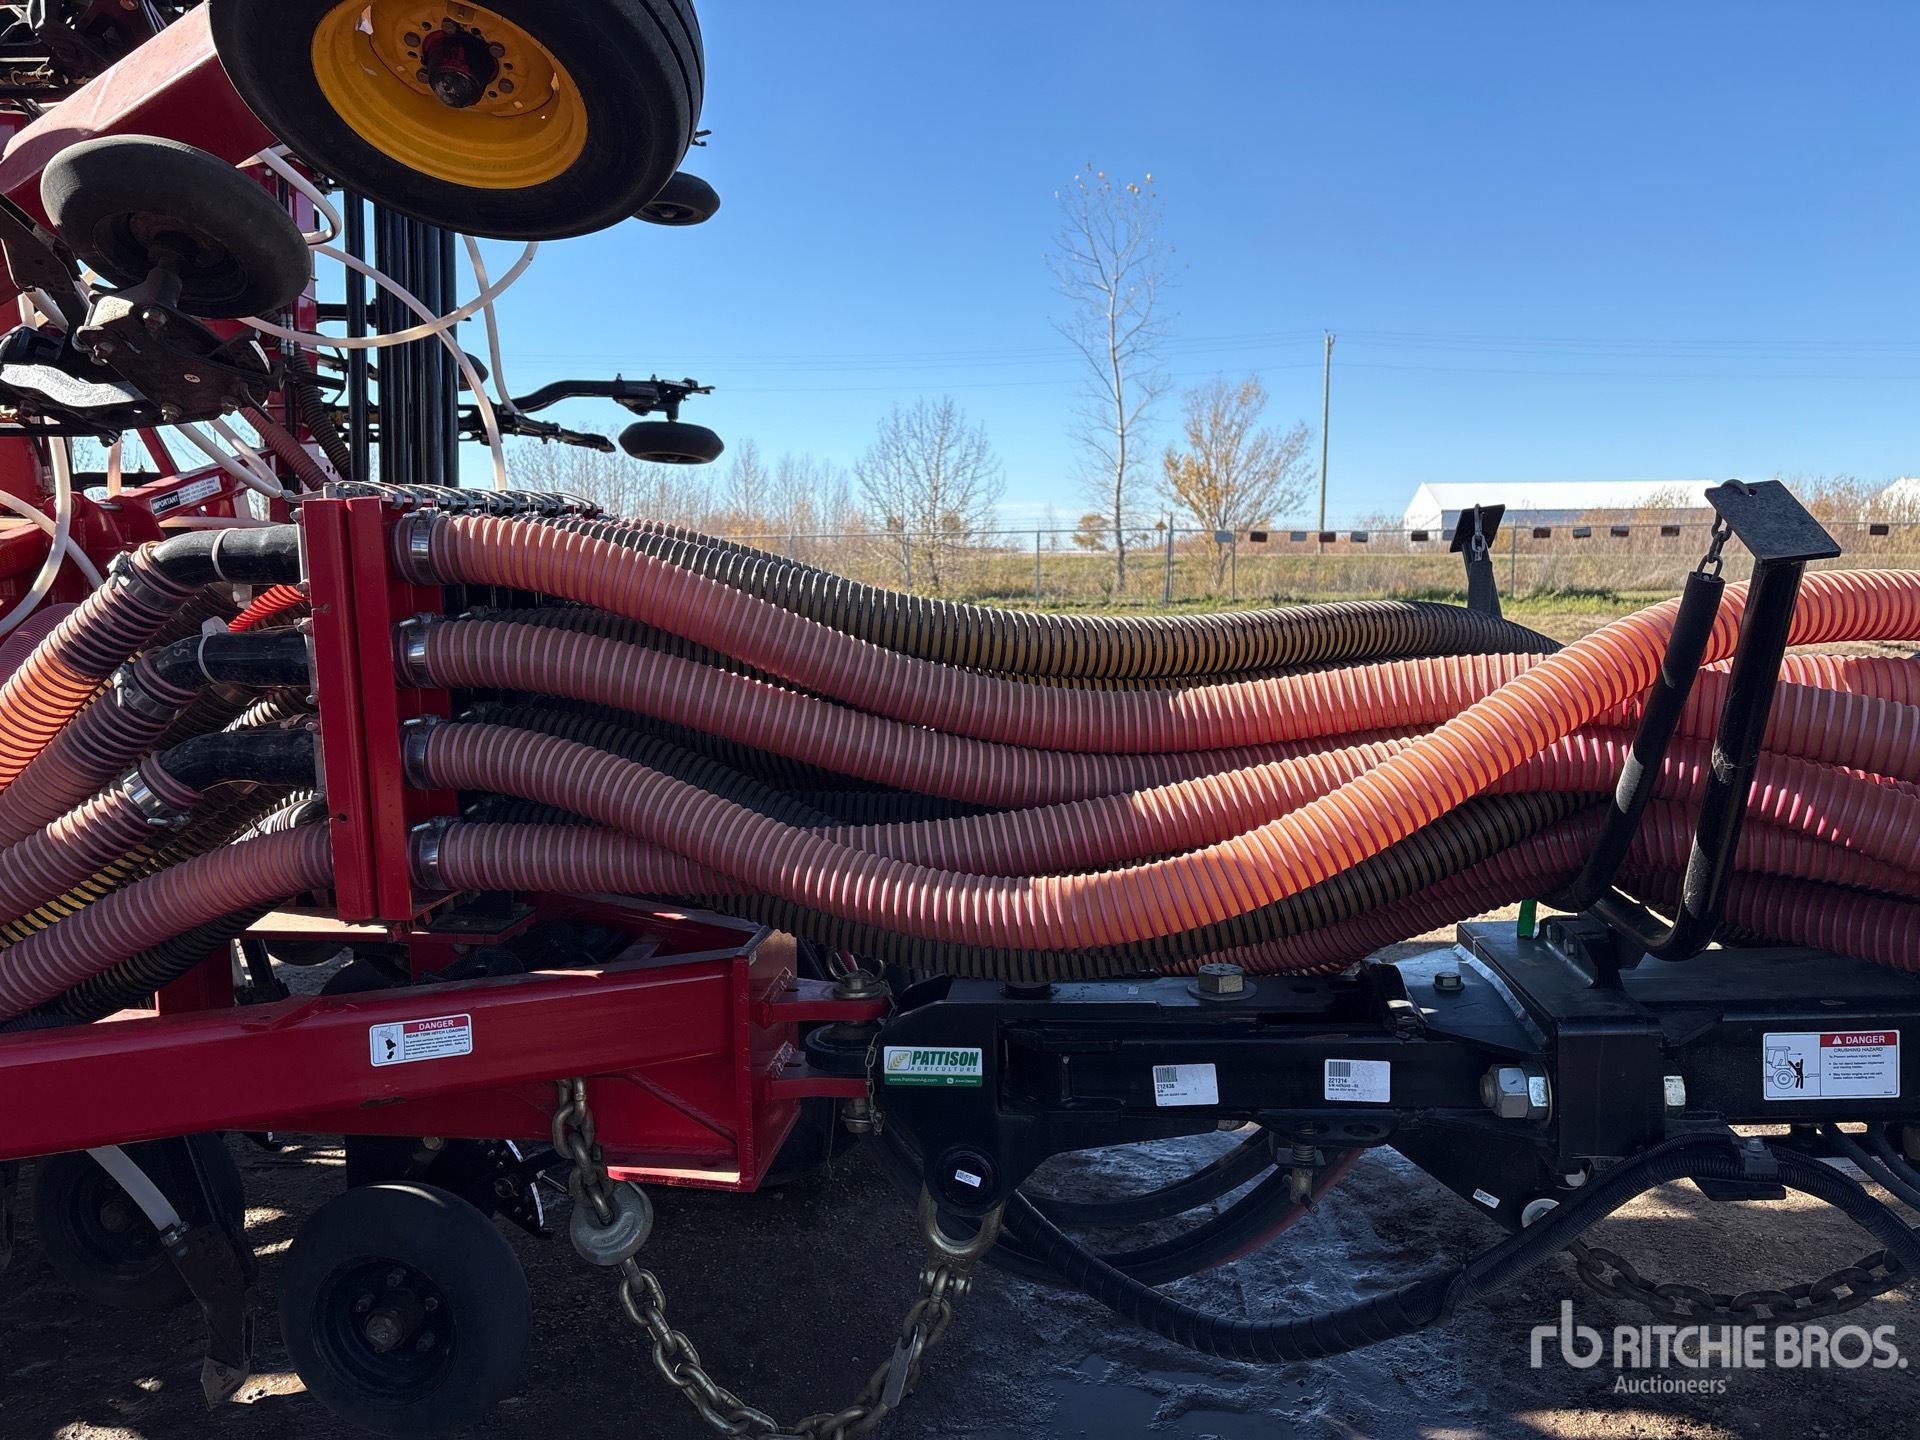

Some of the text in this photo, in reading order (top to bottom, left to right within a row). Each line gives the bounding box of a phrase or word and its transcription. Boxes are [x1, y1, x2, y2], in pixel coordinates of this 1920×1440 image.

[153, 496, 179, 510] IMPORTANT
[419, 1020, 454, 1031] DANGER
[1845, 1036, 1886, 1044] DANGER
[911, 1050, 979, 1067] PATTISON
